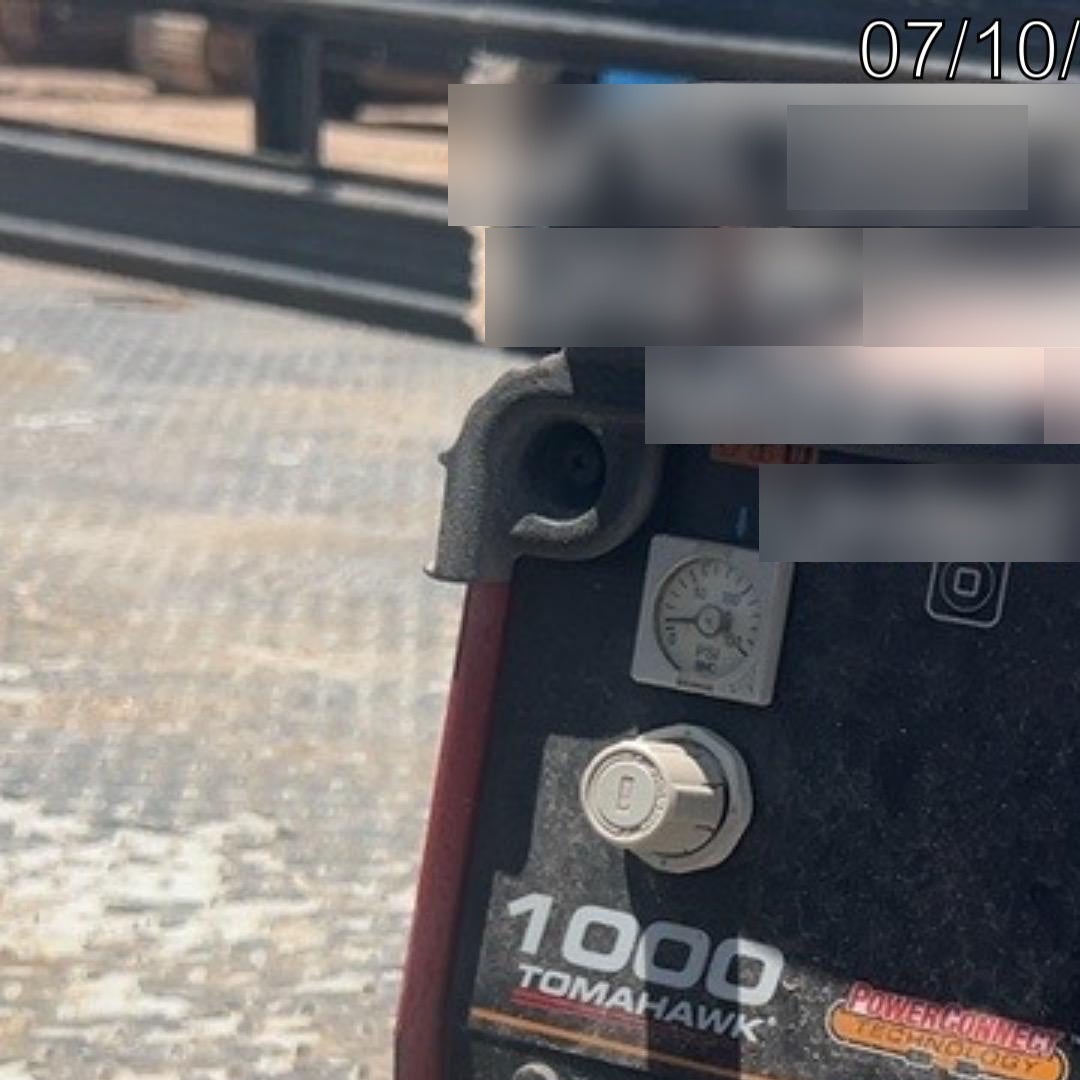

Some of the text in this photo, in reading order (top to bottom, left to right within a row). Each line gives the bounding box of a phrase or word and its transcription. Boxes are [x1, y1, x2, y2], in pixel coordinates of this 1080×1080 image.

[506, 891, 785, 1006] 1000
[516, 962, 766, 1043] TOMAHAWK
[854, 1017, 1040, 1074] TECHNOLOGY
